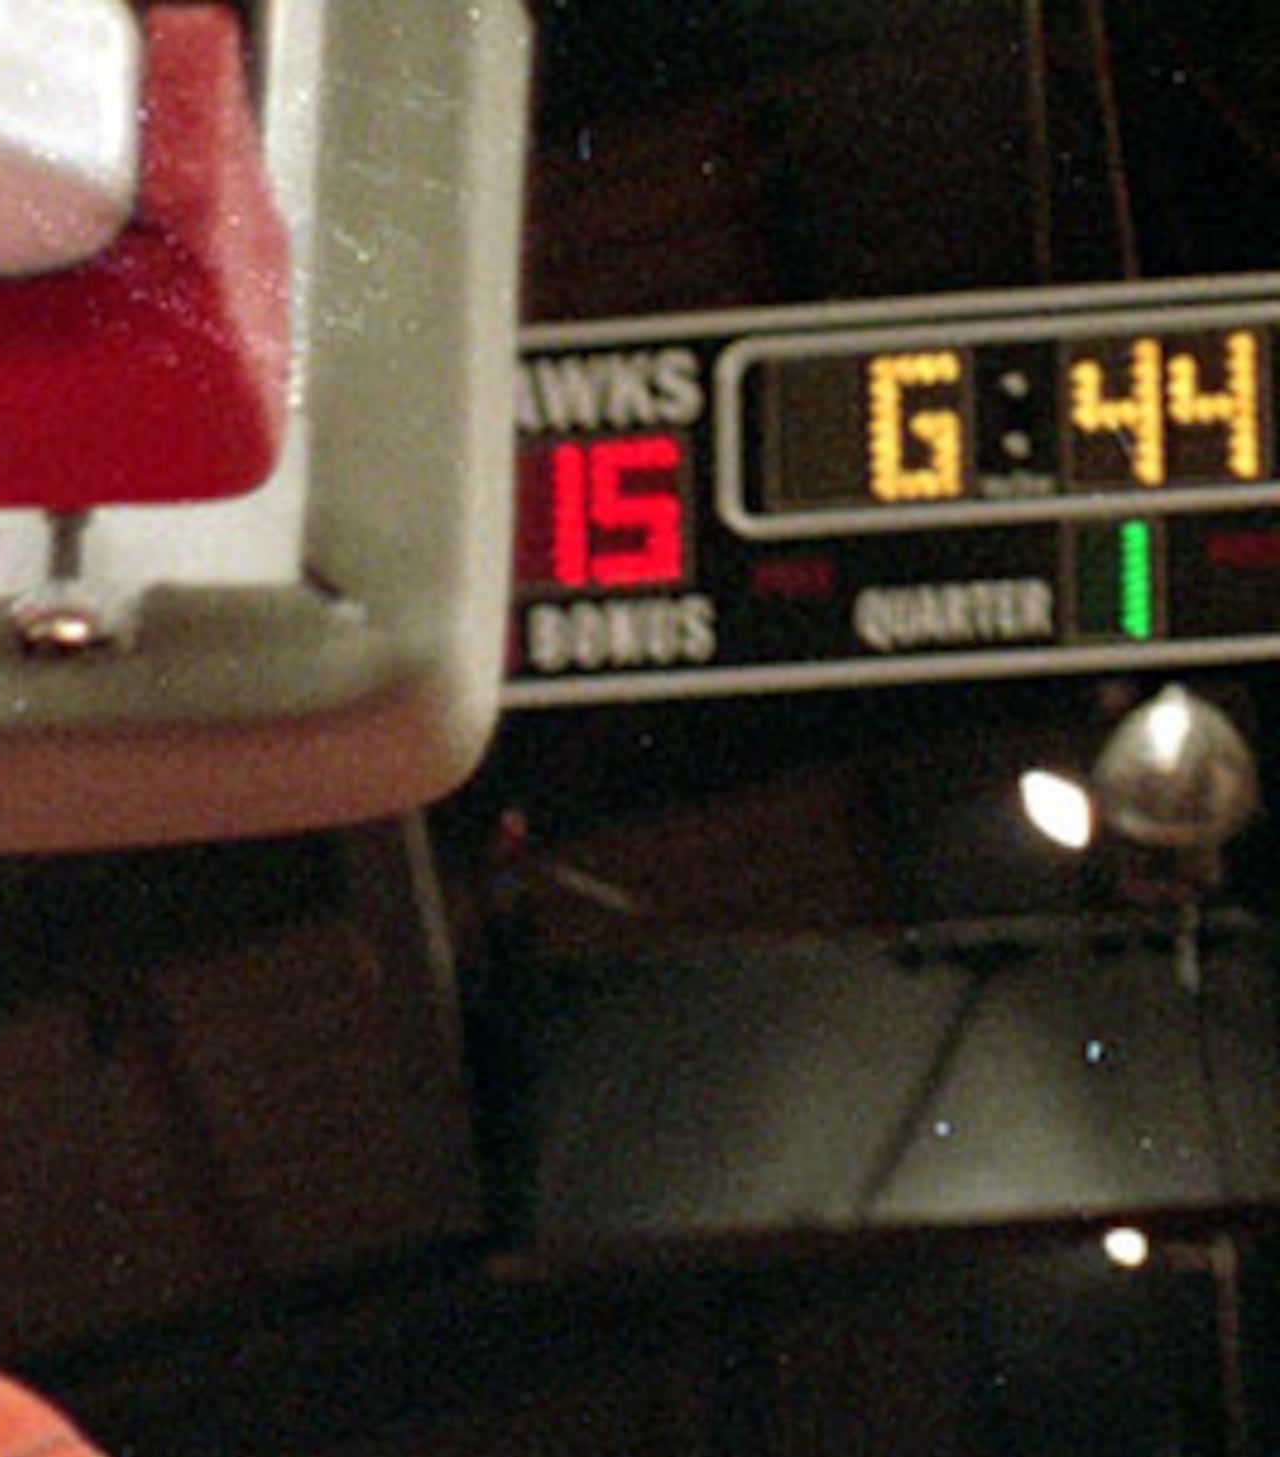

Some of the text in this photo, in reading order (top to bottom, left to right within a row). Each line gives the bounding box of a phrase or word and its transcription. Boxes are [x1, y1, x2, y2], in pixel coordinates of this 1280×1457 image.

[551, 434, 684, 588] 15
[528, 594, 717, 672] BONUS
[854, 577, 1053, 653] QUARTER
